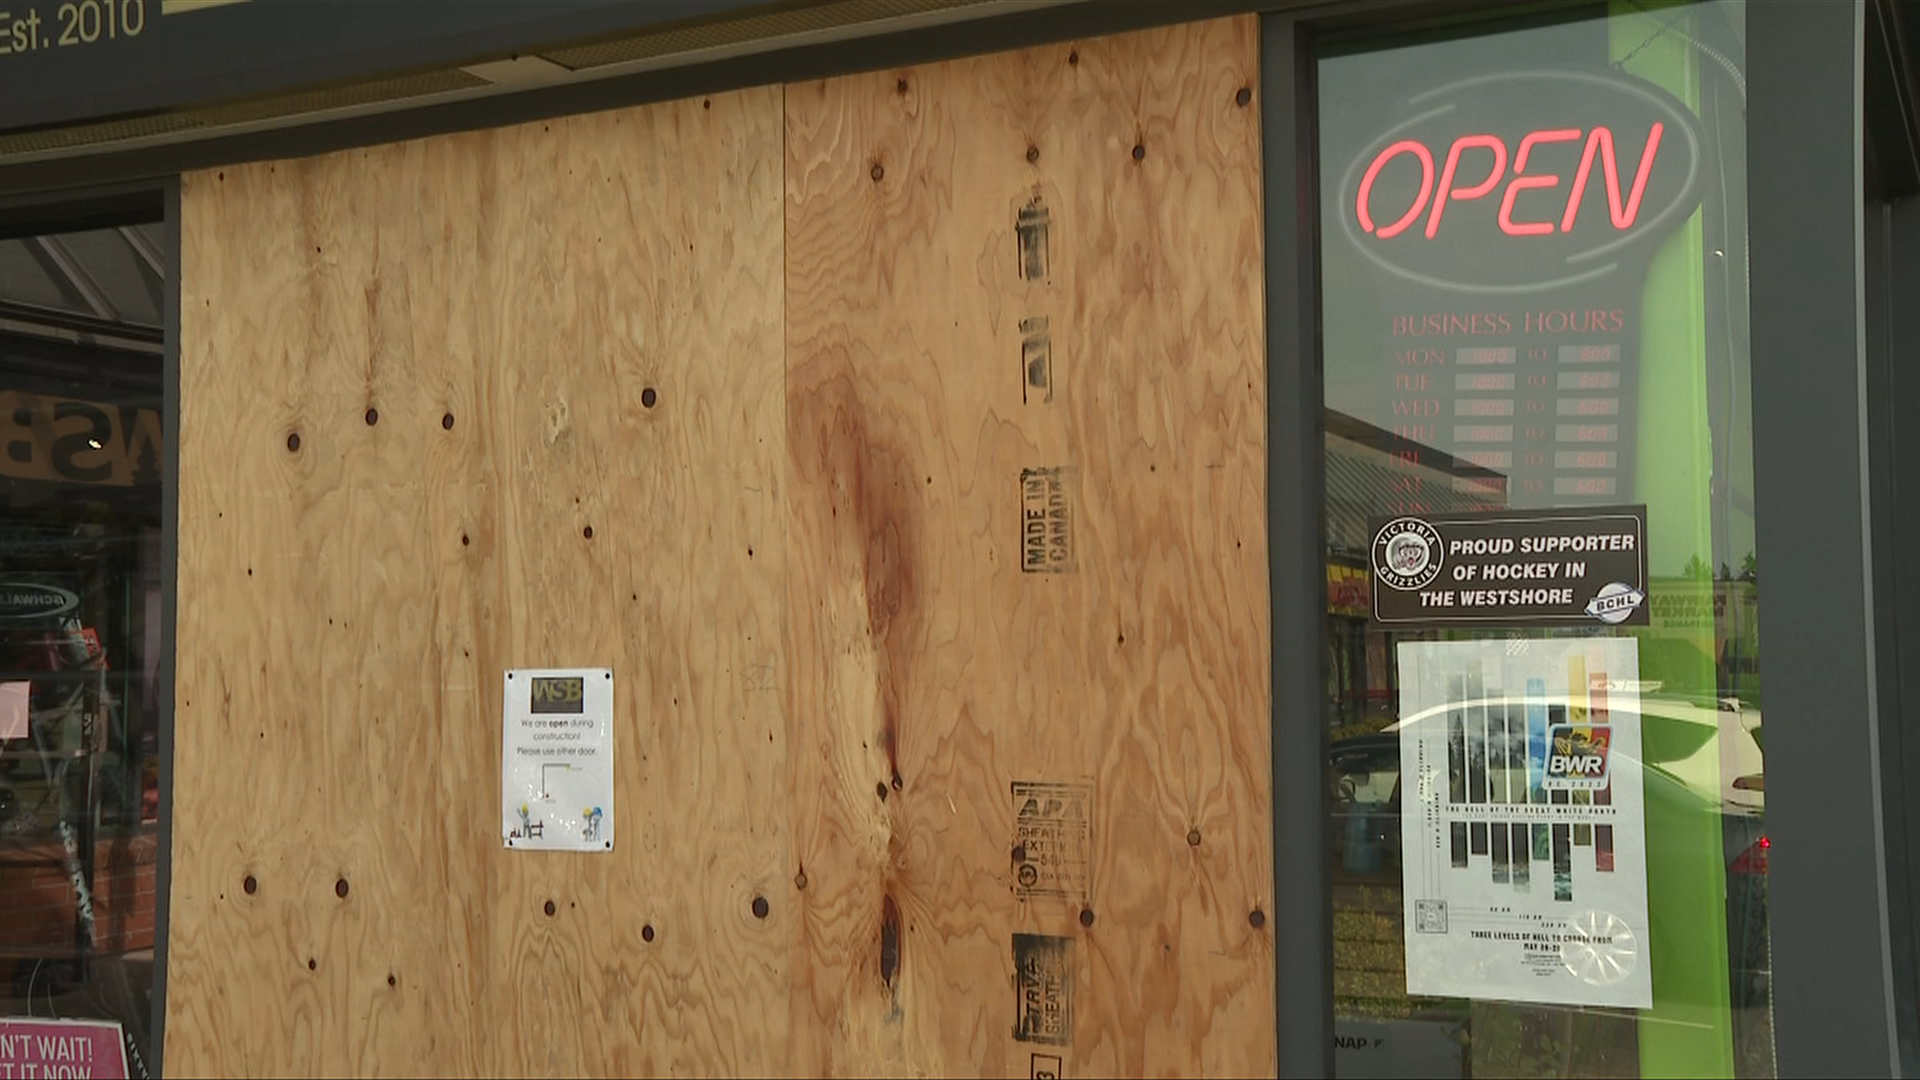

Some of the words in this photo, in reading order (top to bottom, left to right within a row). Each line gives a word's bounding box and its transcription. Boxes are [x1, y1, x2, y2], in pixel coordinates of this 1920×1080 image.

[0, 8, 49, 54] Est.
[57, 0, 145, 46] 2010
[1355, 122, 1663, 239] OPEN
[1392, 312, 1511, 336] BUSINESS
[1524, 309, 1624, 333] HOURS
[1393, 349, 1445, 366] MON
[1392, 399, 1440, 417] WED
[1027, 508, 1046, 565] MADE
[1378, 521, 1436, 545] VICTORIA
[1450, 539, 1514, 555] PROUD
[1520, 534, 1635, 553] SUPPORTER
[1380, 563, 1437, 587] GRIZZLIES
[1453, 565, 1477, 581] OF
[1482, 563, 1558, 579] HOCKEY
[1565, 562, 1586, 578] IN
[1420, 591, 1454, 606] THE
[1460, 588, 1573, 606] WESTSHORE
[1597, 595, 1634, 611] BCHL
[520, 719, 533, 728] We
[548, 720, 568, 729] open
[570, 719, 594, 729] during
[532, 732, 581, 741] construction!
[517, 746, 541, 755] Please
[556, 747, 577, 755] other
[1550, 755, 1602, 774] BWR
[1019, 799, 1083, 818] APA
[1524, 943, 1538, 951] MAY
[37, 1036, 93, 1063] WAIT!
[0, 1063, 14, 1079] T
[20, 1064, 37, 1079] IT
[43, 1065, 92, 1079] NOW
